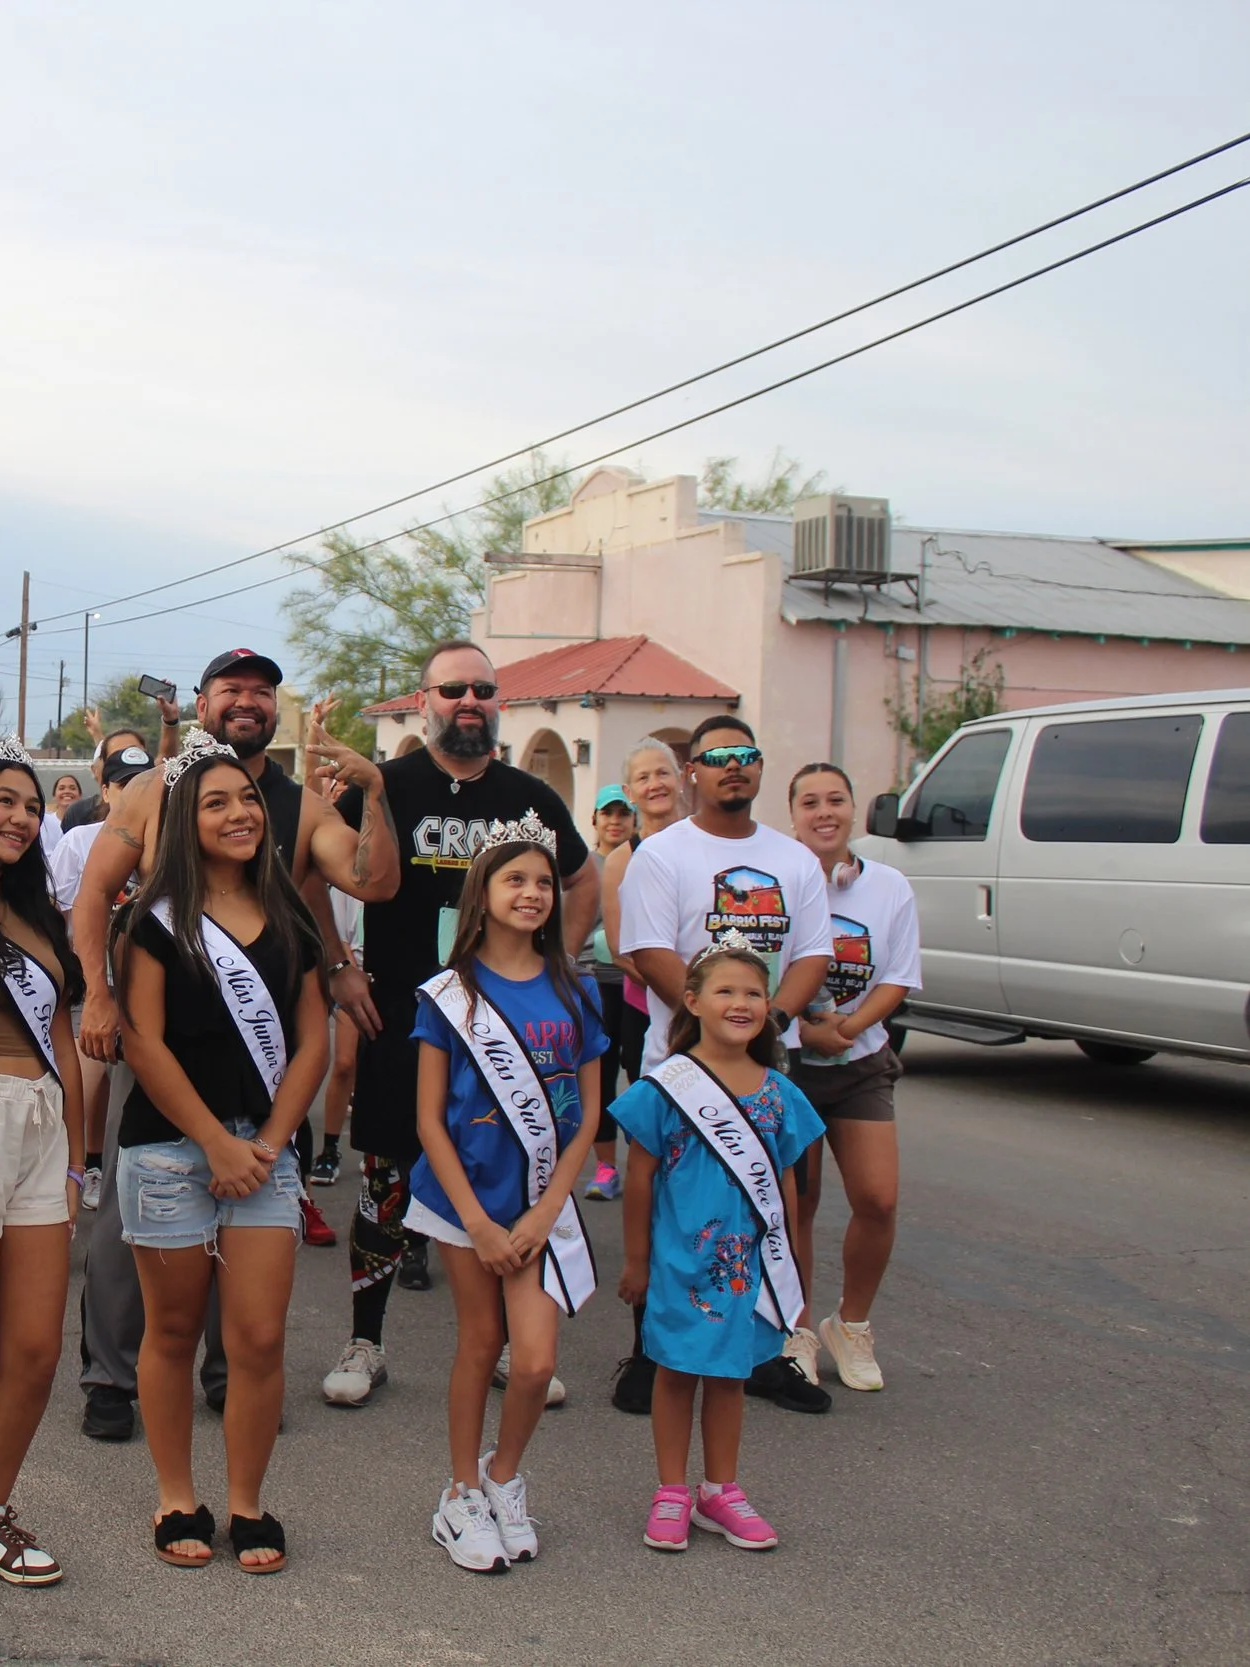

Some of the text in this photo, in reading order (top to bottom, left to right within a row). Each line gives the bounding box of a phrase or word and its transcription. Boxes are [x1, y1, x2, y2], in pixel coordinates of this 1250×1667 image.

[412, 816, 491, 858] CRO
[707, 914, 789, 932] BARRIO FEST
[840, 962, 874, 980] FEST
[215, 956, 279, 1069] Miss Junior
[524, 1020, 576, 1068] ARR
[472, 1022, 516, 1082] Miss
[510, 1090, 548, 1138] Sub
[698, 1105, 784, 1262] Miss Wee Miss
